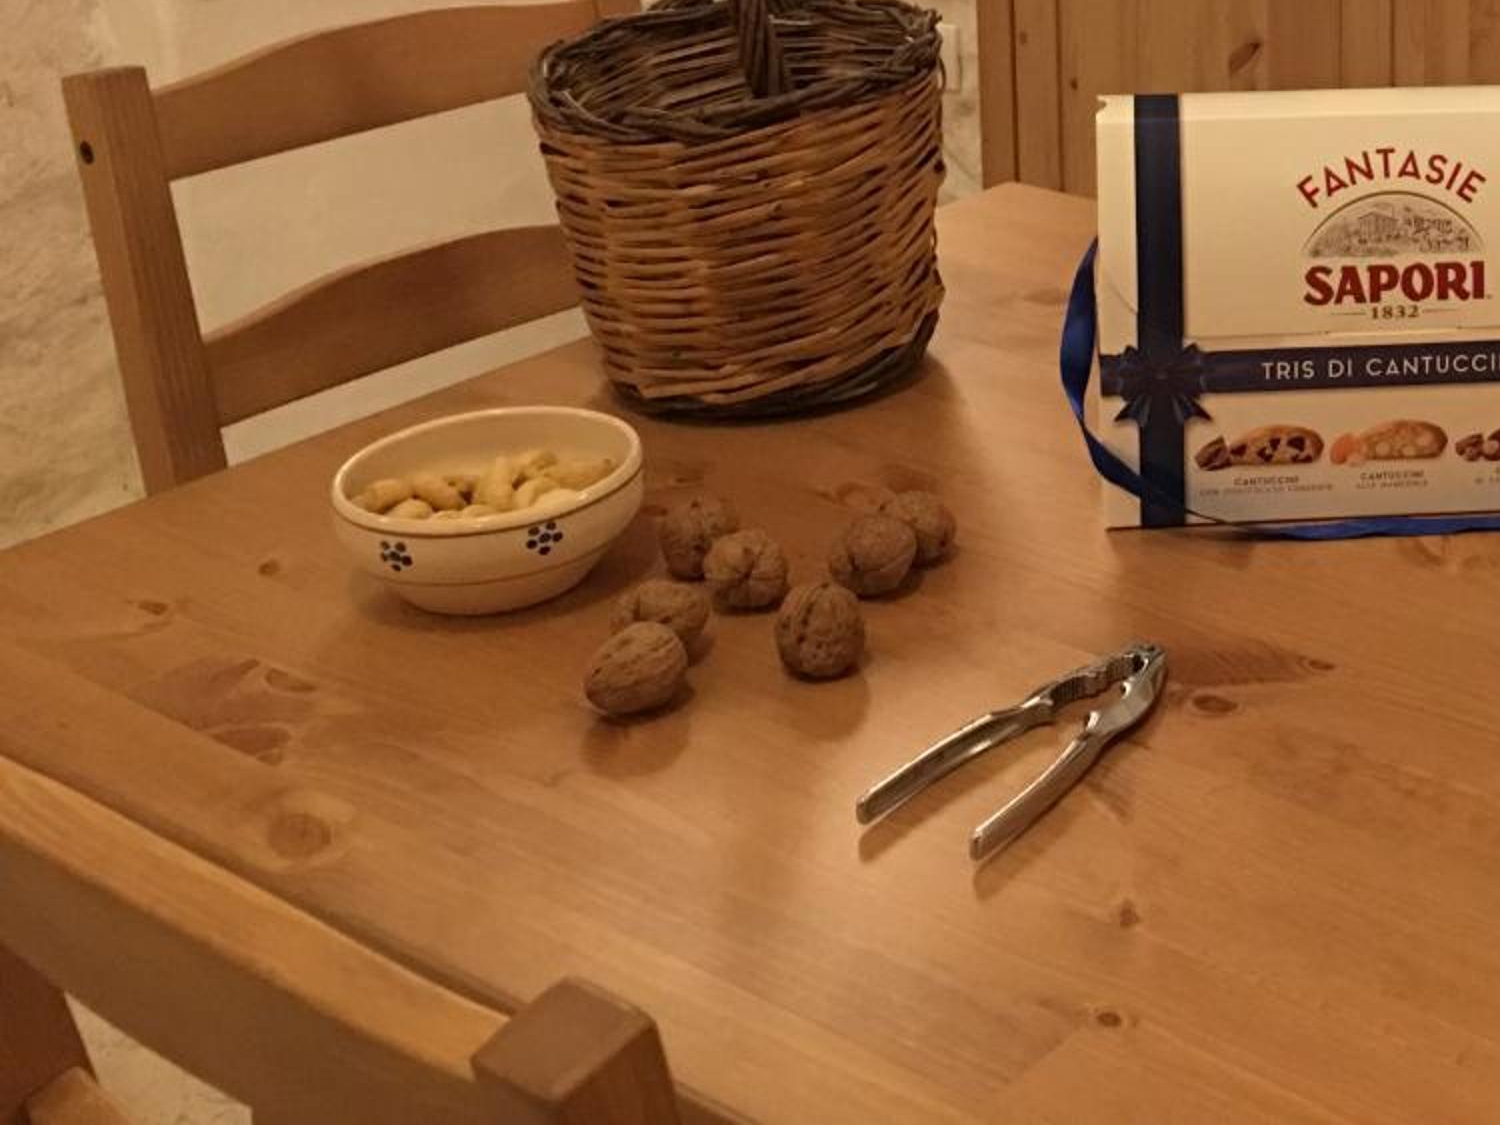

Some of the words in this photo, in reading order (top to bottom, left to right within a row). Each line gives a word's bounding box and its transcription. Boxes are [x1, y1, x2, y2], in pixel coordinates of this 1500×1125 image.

[1297, 148, 1486, 208] FANTASIE
[1304, 261, 1485, 305] SAPORI
[1371, 305, 1420, 320] 1832
[1261, 360, 1315, 379] TRIS
[1328, 358, 1353, 378] DI
